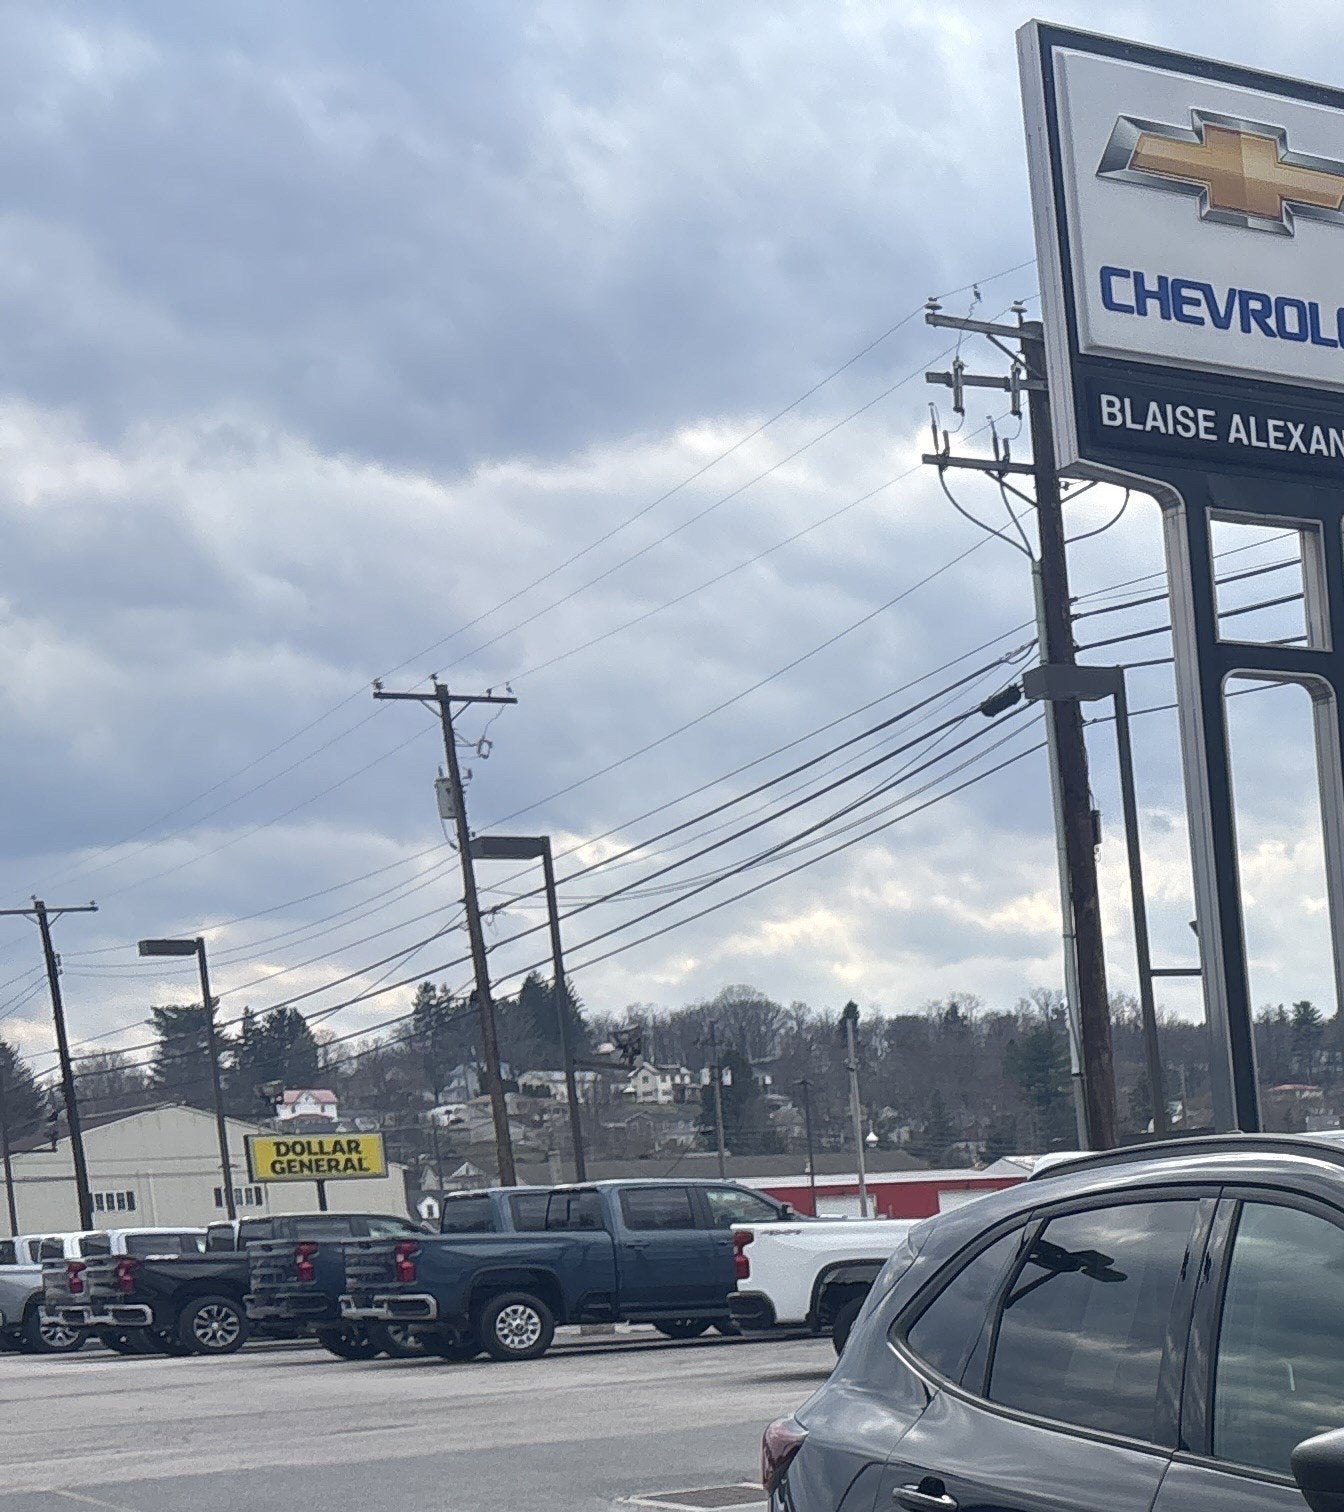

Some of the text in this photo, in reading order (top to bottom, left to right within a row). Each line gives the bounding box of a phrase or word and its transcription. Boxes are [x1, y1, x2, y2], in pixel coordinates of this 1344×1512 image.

[1100, 394, 1218, 441] BLAISE
[273, 1139, 362, 1157] DOLLAR
[270, 1156, 371, 1175] GENERAL
